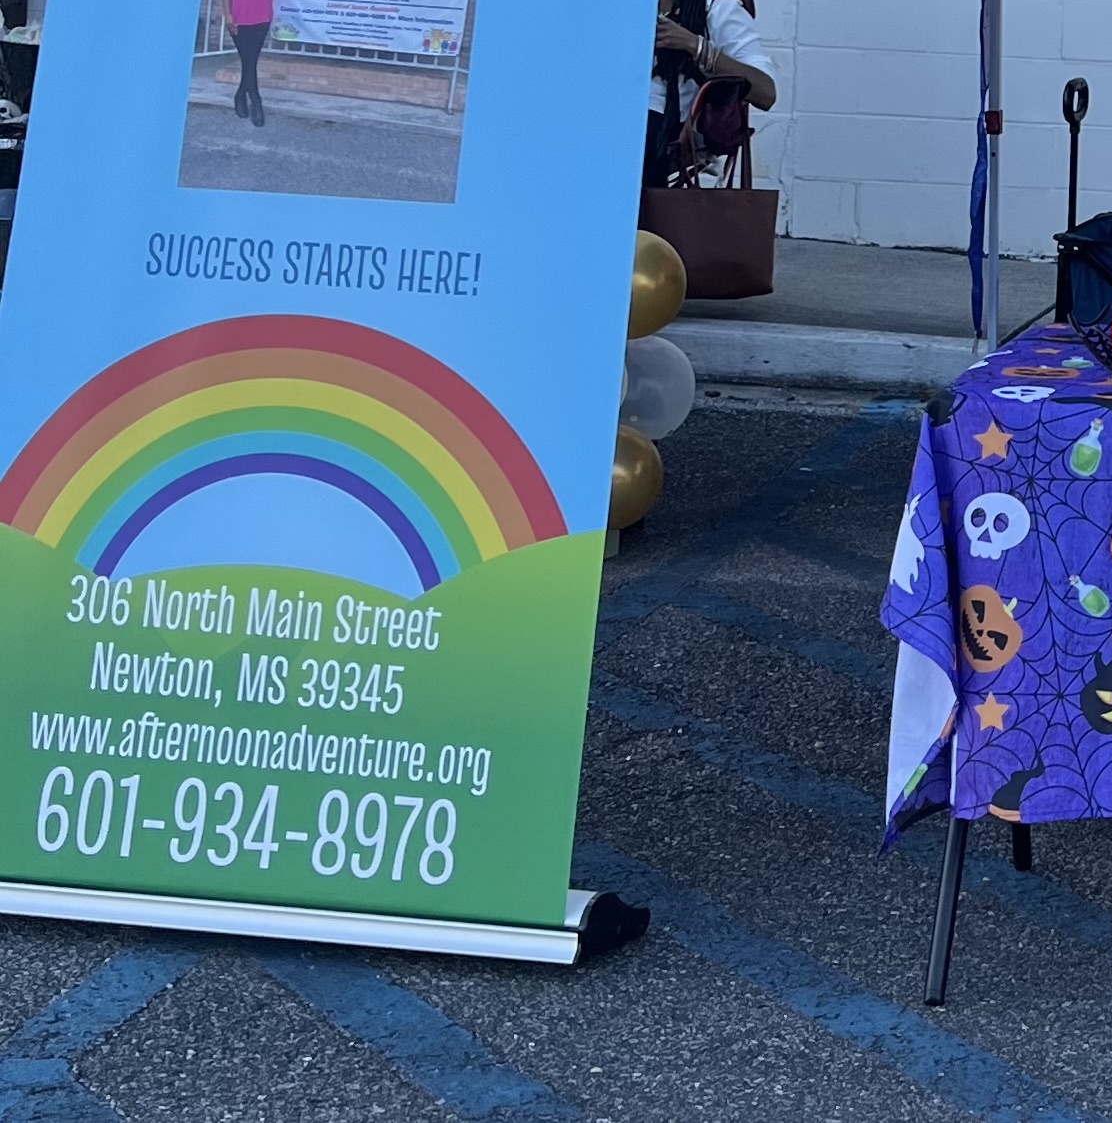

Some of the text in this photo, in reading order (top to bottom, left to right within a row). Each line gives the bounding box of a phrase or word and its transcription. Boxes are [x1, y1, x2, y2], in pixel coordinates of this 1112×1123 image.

[146, 232, 482, 296] SUCCESS STARTS HERE!
[66, 574, 442, 650] 306 North Main Street
[90, 641, 405, 715] Newton, MS 39345
[30, 711, 492, 795] www.afternoonadventure.org
[36, 766, 457, 886] 601-934-8978
